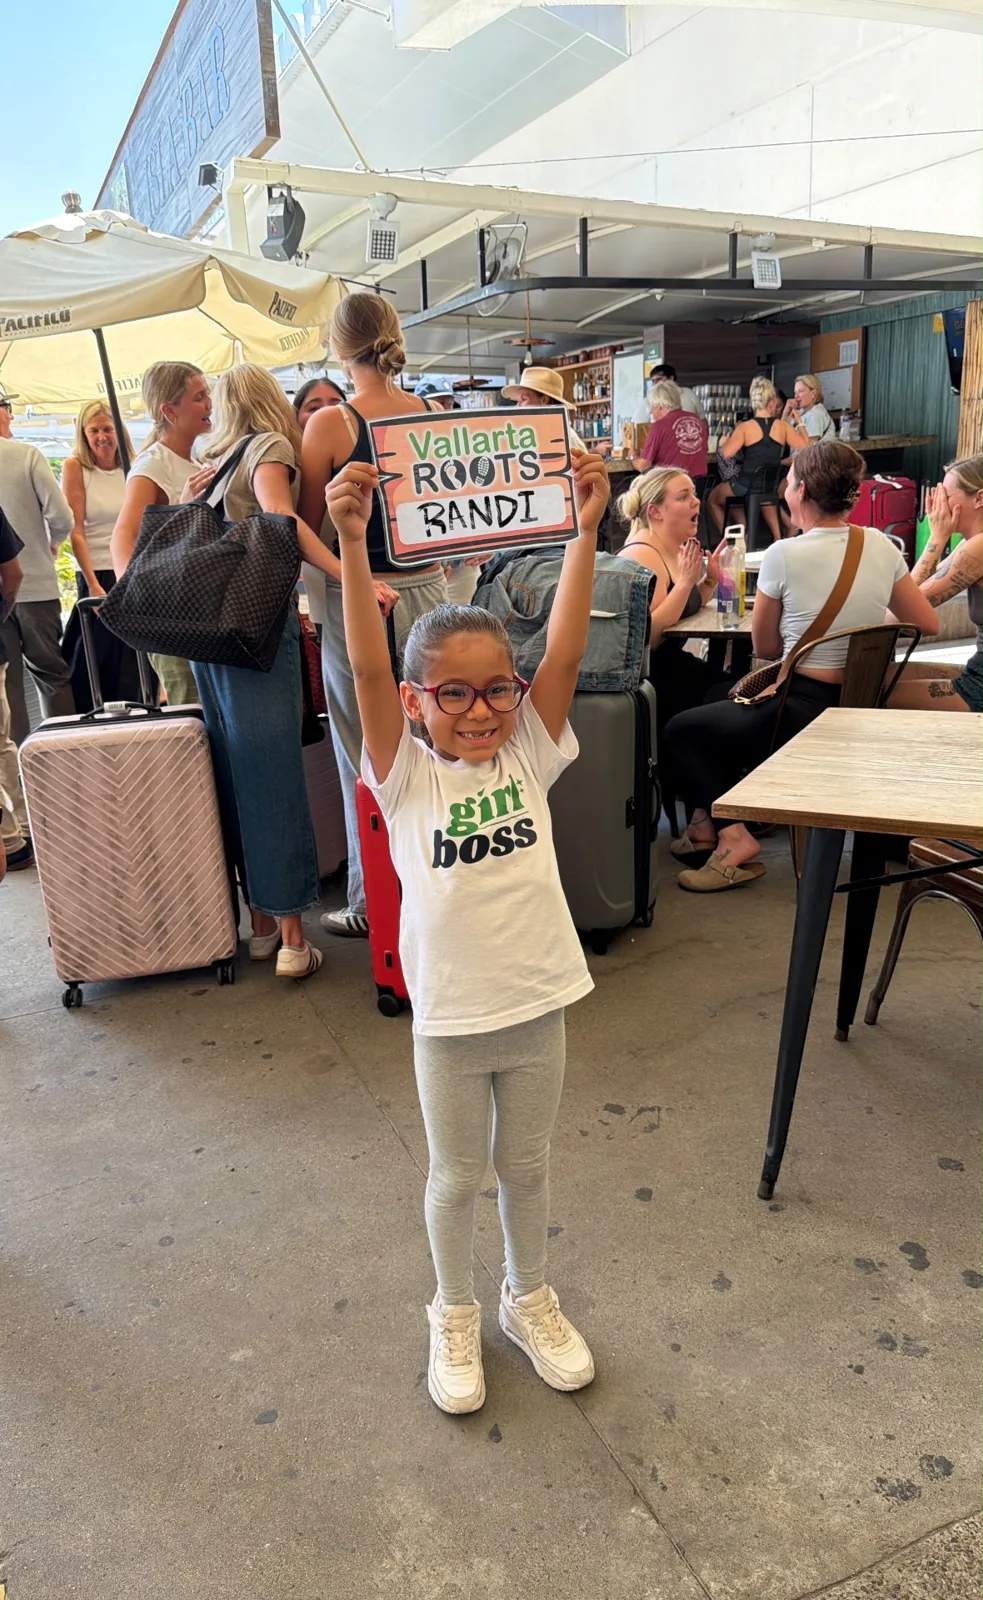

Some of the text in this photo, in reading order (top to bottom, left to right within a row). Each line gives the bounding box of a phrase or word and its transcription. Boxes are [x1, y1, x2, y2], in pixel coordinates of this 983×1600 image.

[180, 22, 231, 171] BAR
[409, 422, 538, 461] Vallarta
[412, 450, 541, 495] ROOTS
[416, 490, 539, 538] RANDI
[446, 774, 525, 837] girl
[432, 818, 538, 869] boss
